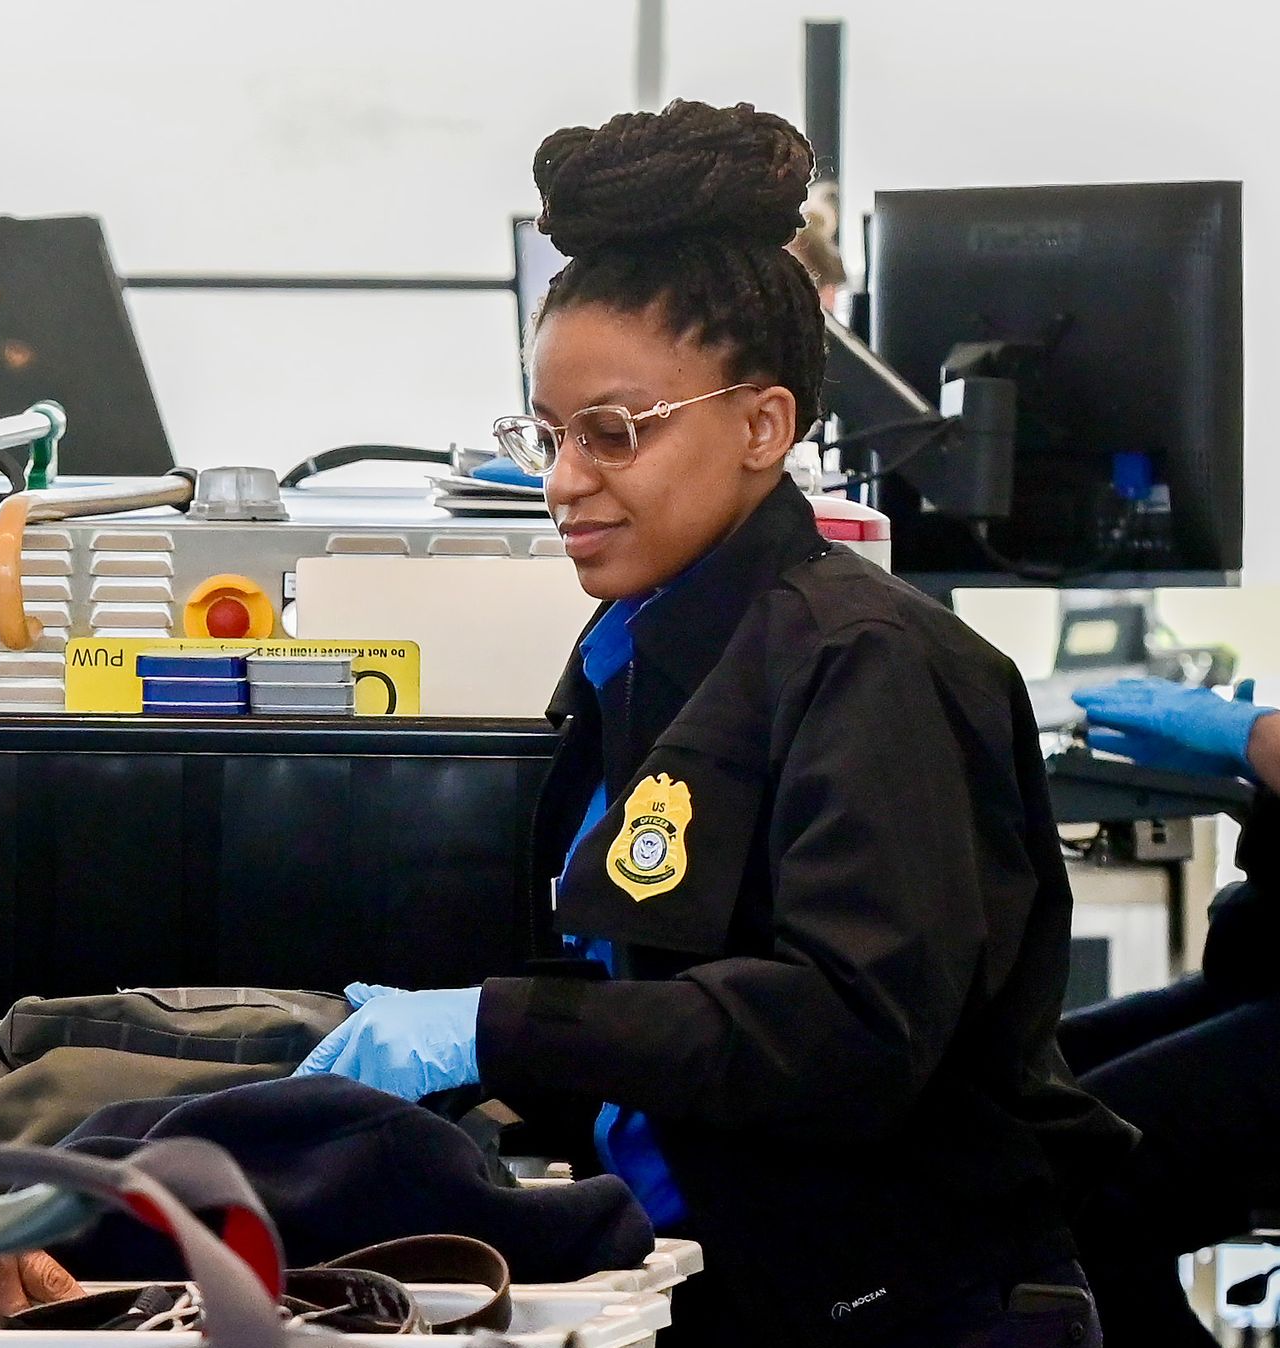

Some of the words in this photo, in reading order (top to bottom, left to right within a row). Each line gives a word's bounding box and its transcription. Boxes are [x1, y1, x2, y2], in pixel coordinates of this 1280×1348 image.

[71, 648, 123, 667] PUW
[368, 648, 388, 658] Not
[391, 648, 405, 658] Do
[652, 801, 666, 813] US
[639, 816, 670, 829] OFFICER
[851, 1287, 887, 1308] MOCEAN
